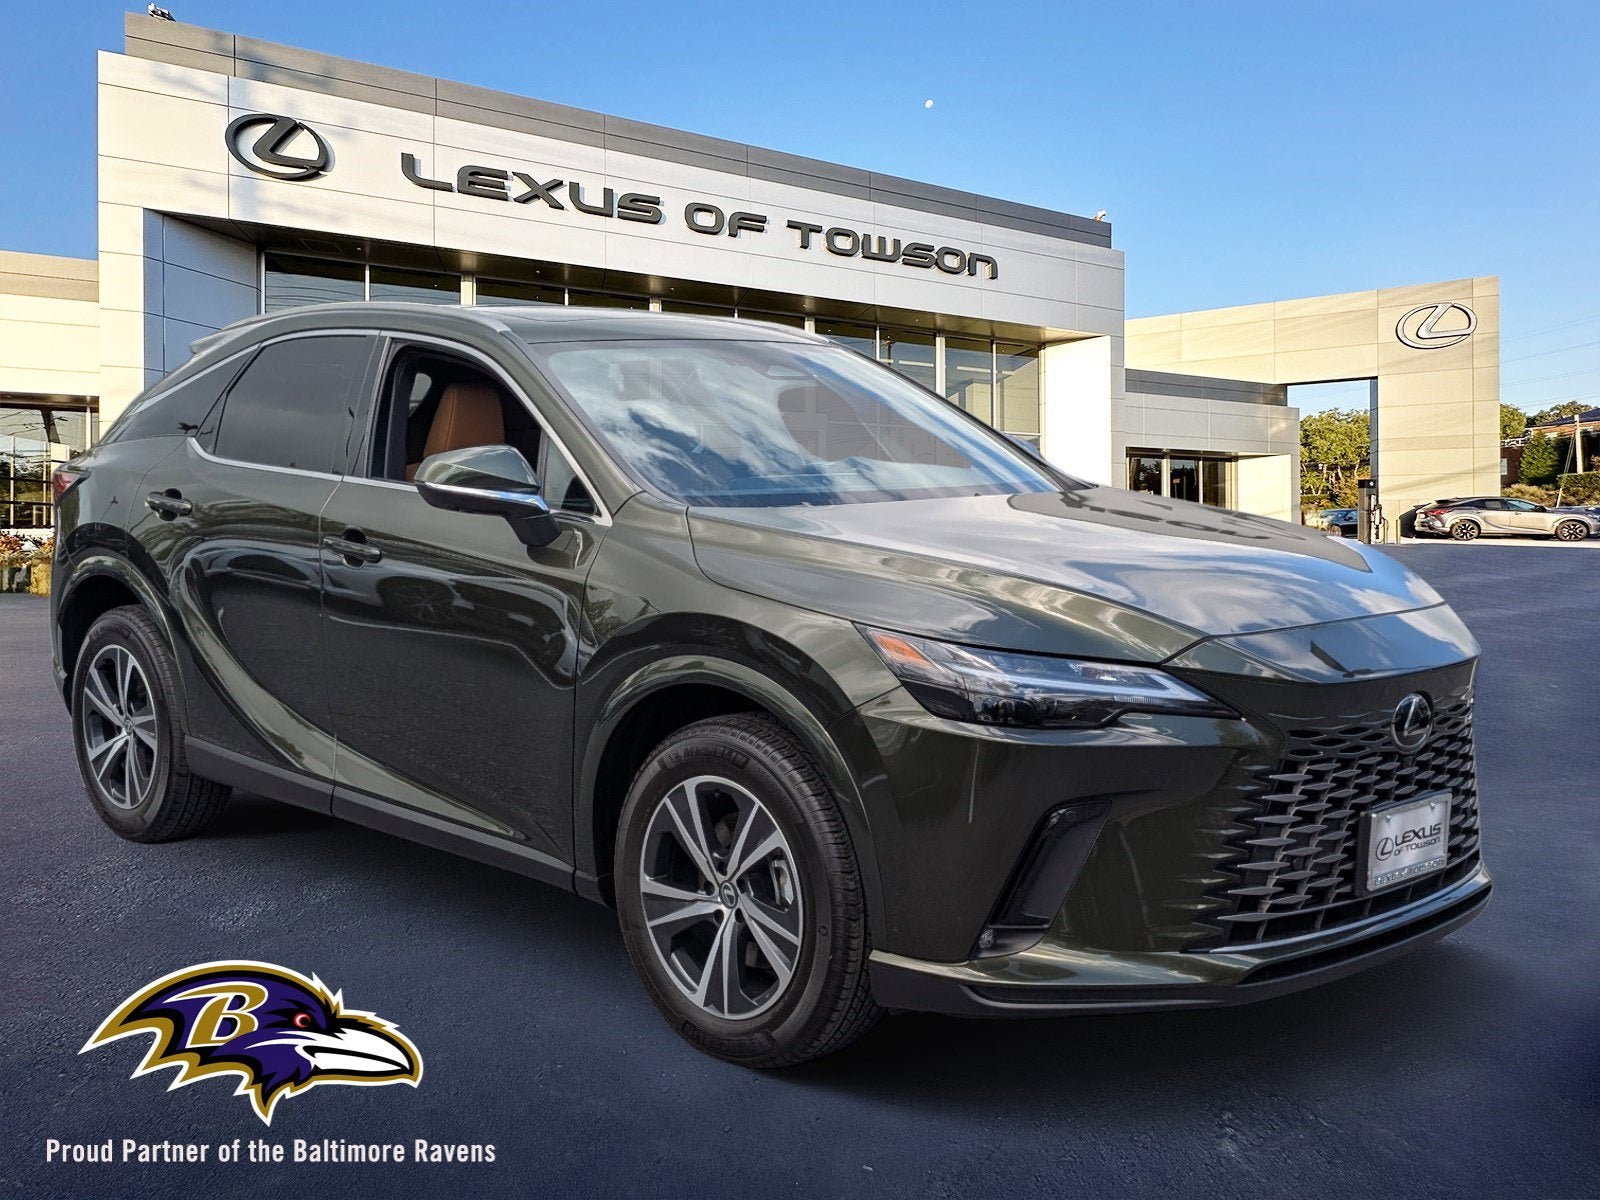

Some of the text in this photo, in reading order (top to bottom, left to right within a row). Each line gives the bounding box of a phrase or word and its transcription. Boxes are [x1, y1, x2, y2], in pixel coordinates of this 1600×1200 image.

[400, 152, 999, 281] LEXUS OF TOWSON
[1394, 837, 1441, 857] OF TOWSON
[1395, 823, 1442, 847] LEXUS
